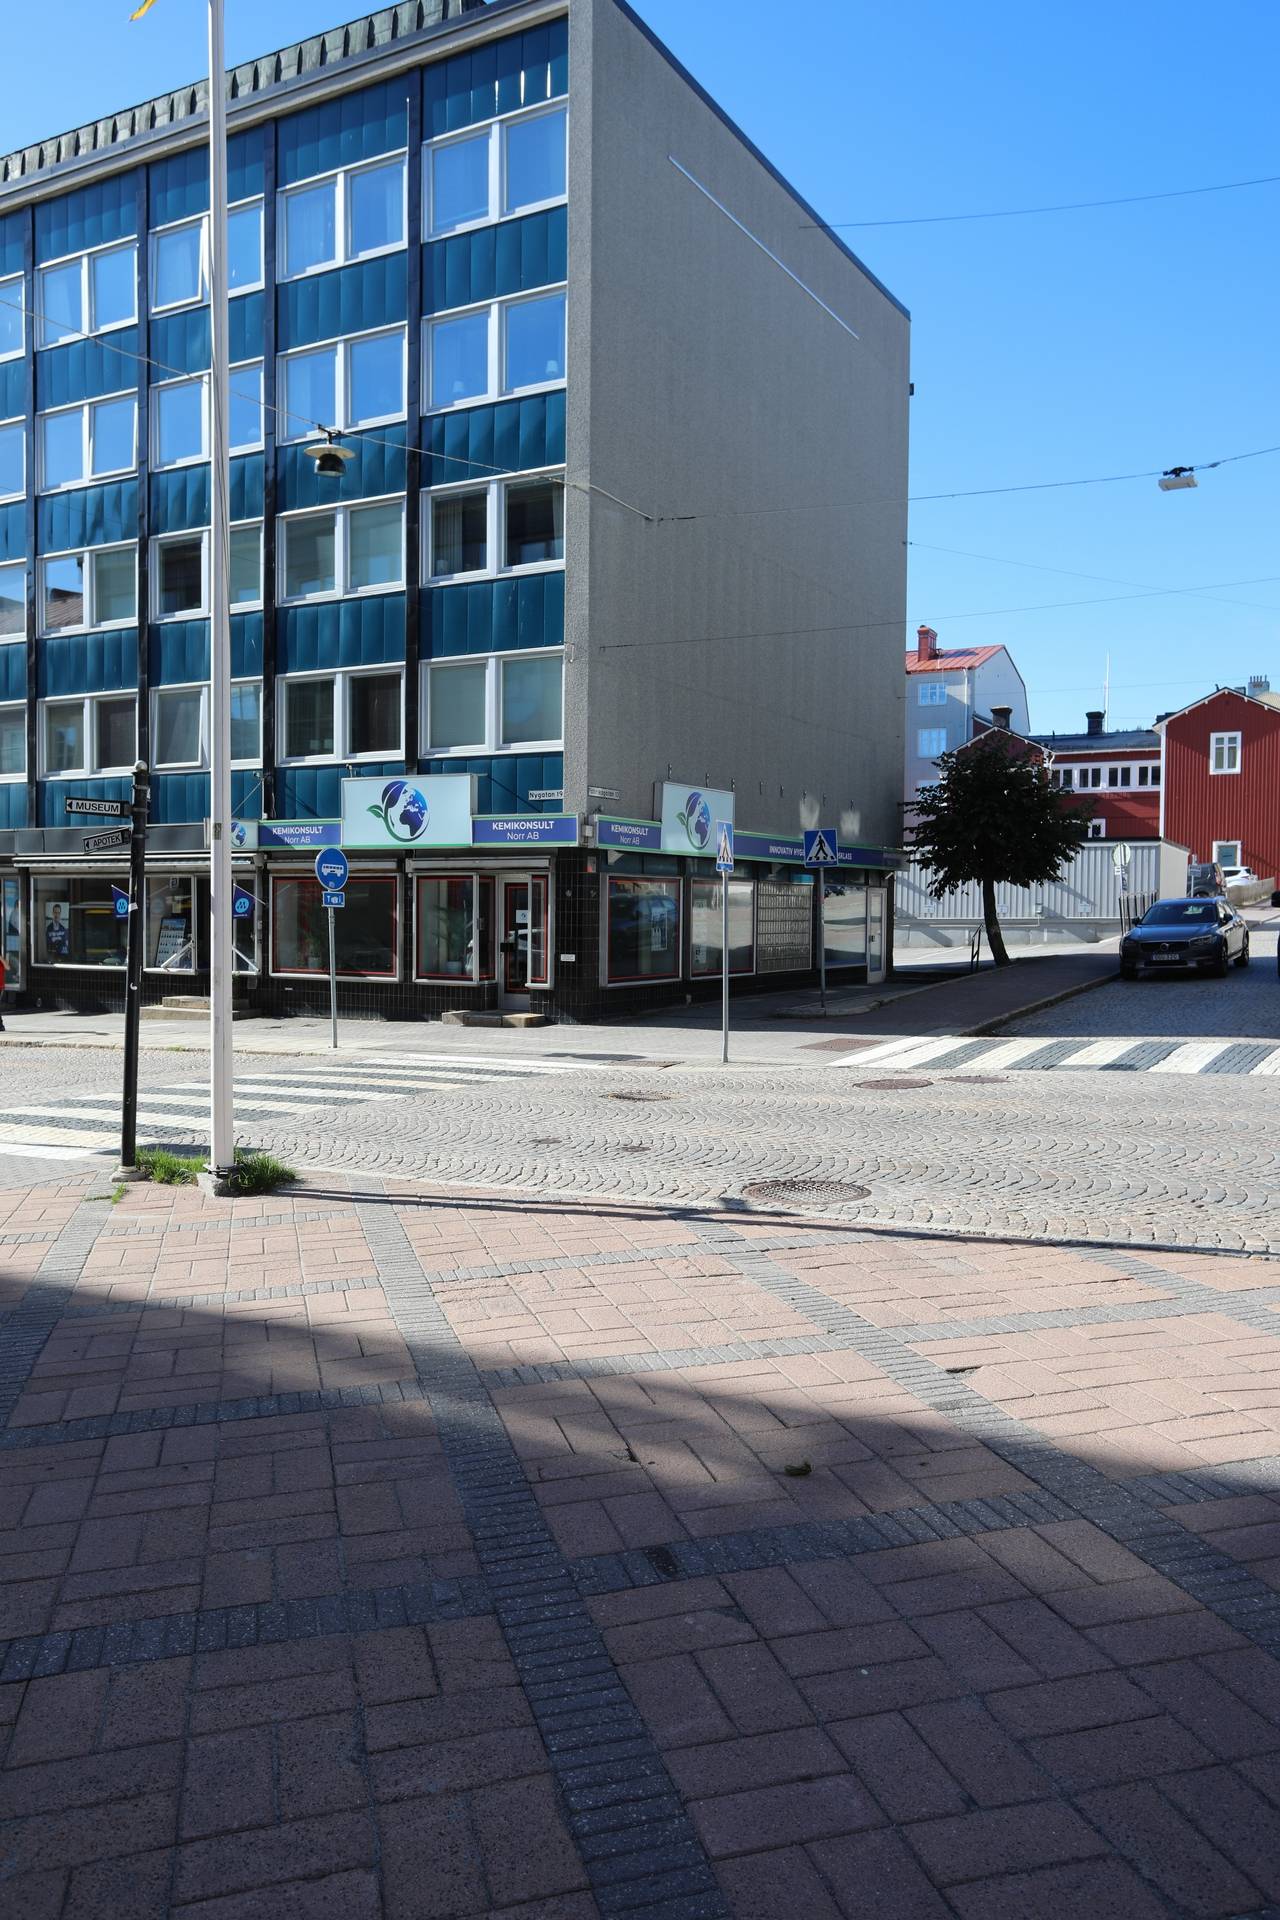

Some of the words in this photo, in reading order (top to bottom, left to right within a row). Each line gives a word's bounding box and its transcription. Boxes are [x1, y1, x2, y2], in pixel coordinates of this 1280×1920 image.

[529, 791, 555, 799] Nygatan
[75, 801, 119, 813] MUSEUM
[492, 821, 555, 830] KEMIKONSULT
[611, 824, 649, 836] KEMIKONSULT
[272, 826, 323, 835] KEMIKONSULT
[284, 836, 300, 844] Norr
[300, 836, 311, 844] AB
[507, 832, 525, 840] Norr
[526, 832, 540, 840] AB
[620, 835, 631, 844] Norr
[631, 836, 640, 845] AB
[93, 834, 121, 848] APOTEK
